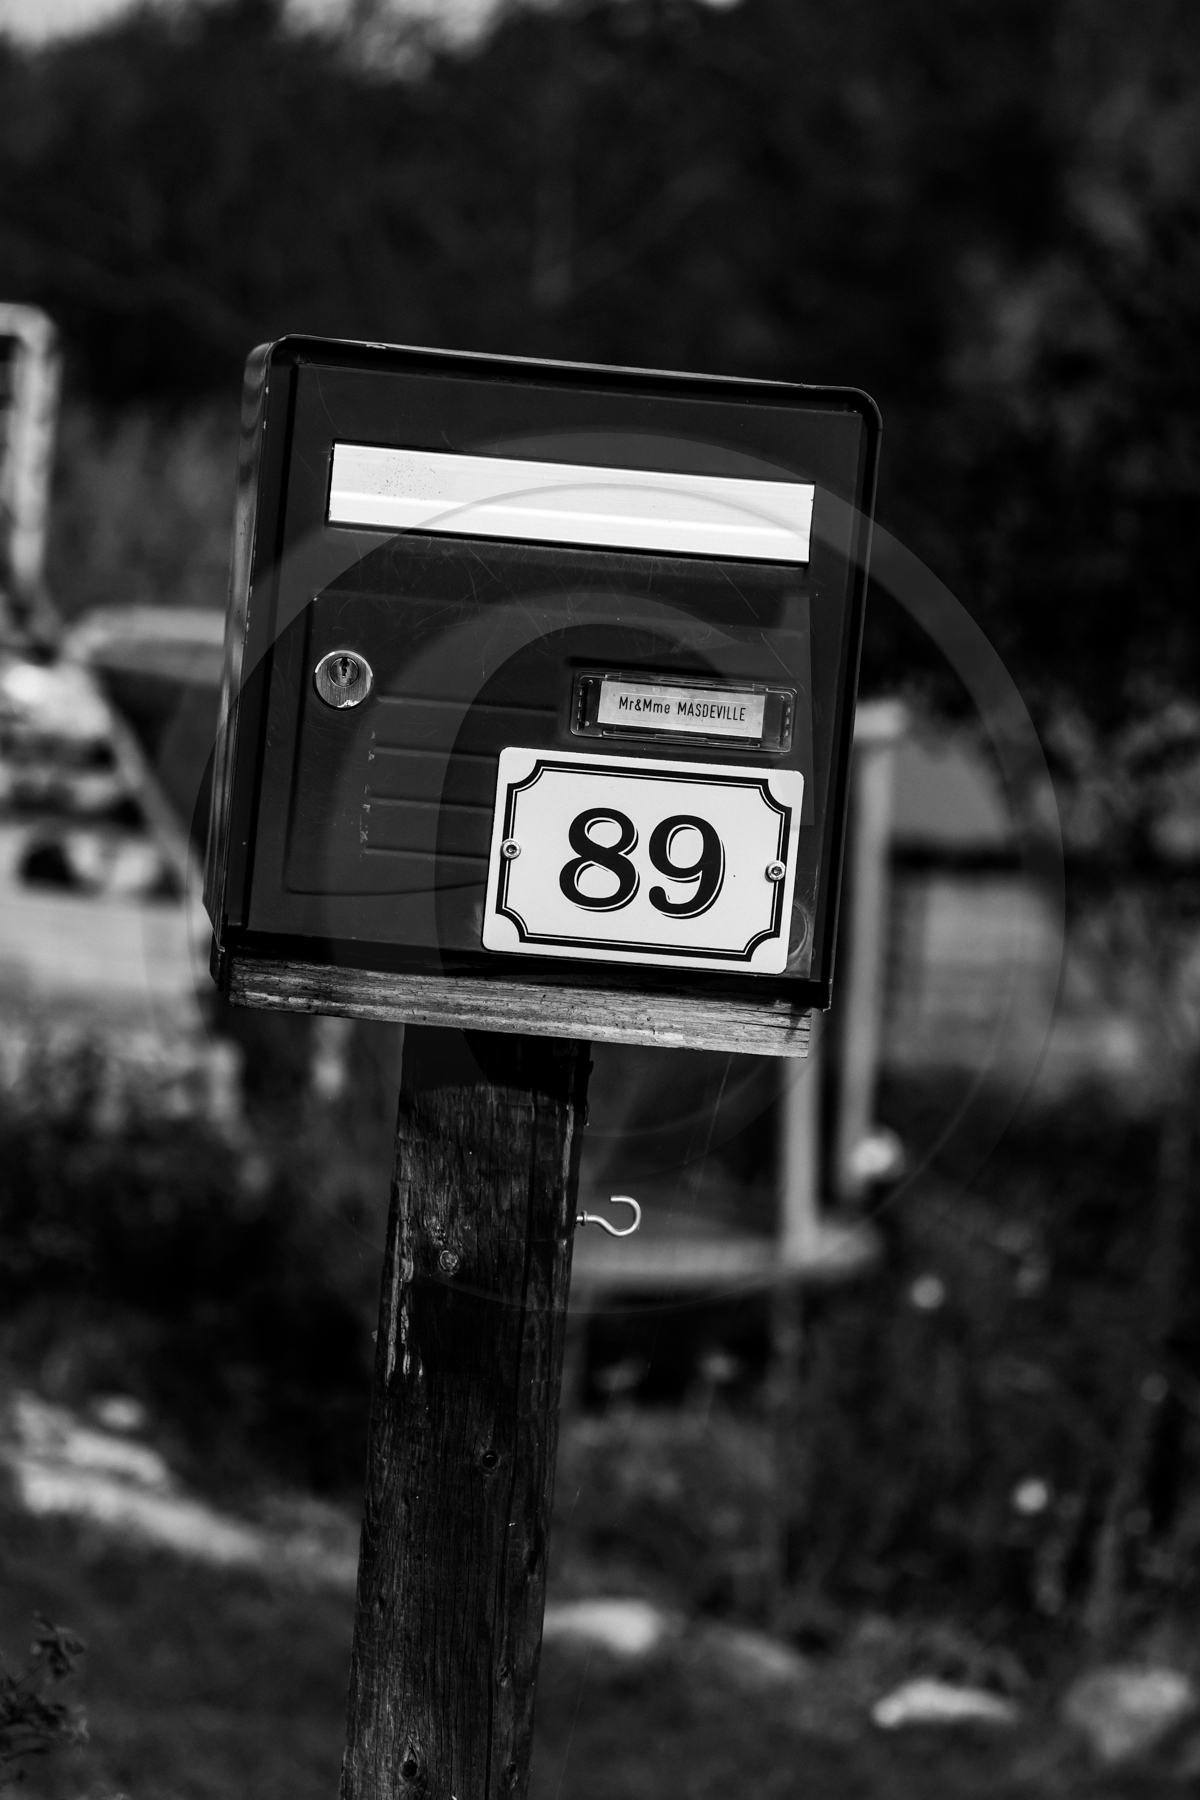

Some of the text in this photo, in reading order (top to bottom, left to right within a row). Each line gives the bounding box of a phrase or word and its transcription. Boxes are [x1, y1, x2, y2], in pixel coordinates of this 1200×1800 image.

[619, 696, 746, 722] Mr&Mme MASDEVILLE
[559, 807, 726, 920] 89
